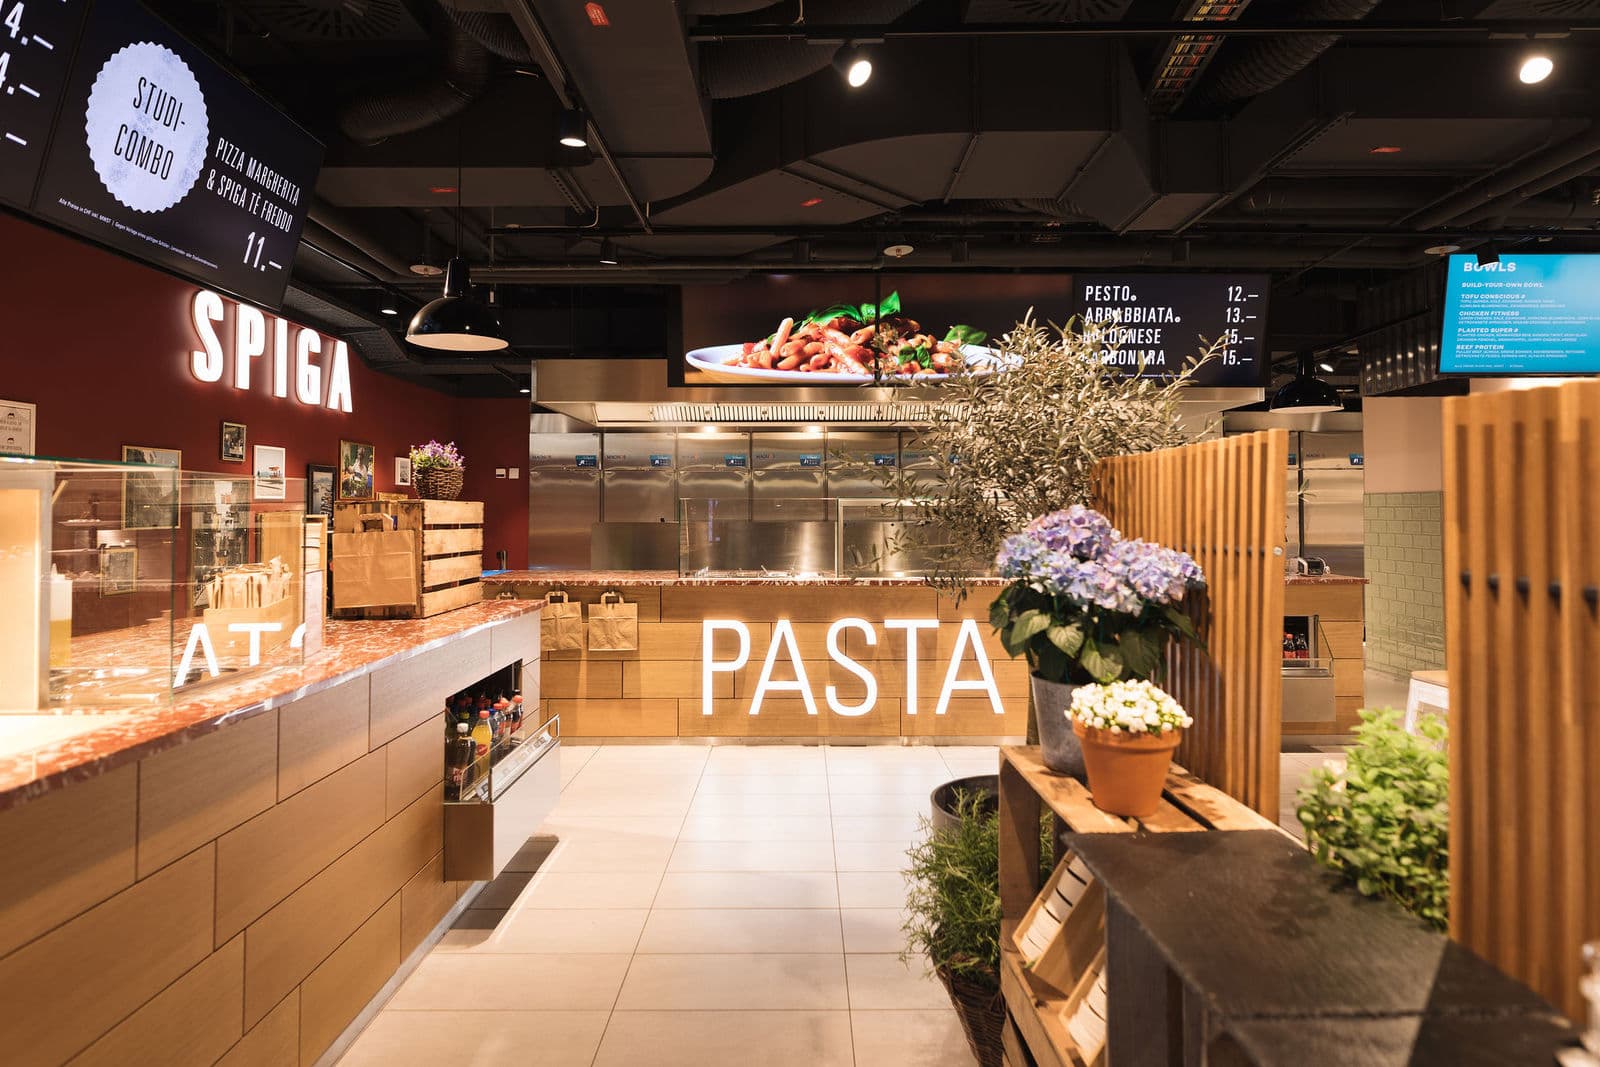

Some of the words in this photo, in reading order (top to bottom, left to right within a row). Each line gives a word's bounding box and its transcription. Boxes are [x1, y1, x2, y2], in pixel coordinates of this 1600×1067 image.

[132, 76, 185, 132] STUDI-
[113, 123, 174, 181] COMBO
[215, 137, 245, 172] PIZZA
[246, 157, 300, 206] MARGHERITA
[206, 169, 216, 191] &
[217, 175, 247, 208] SPIGA
[260, 200, 293, 232] FREDDO
[1463, 262, 1517, 272] BOWLS
[190, 289, 353, 413] SPIGA
[702, 617, 1005, 716] PASTA
